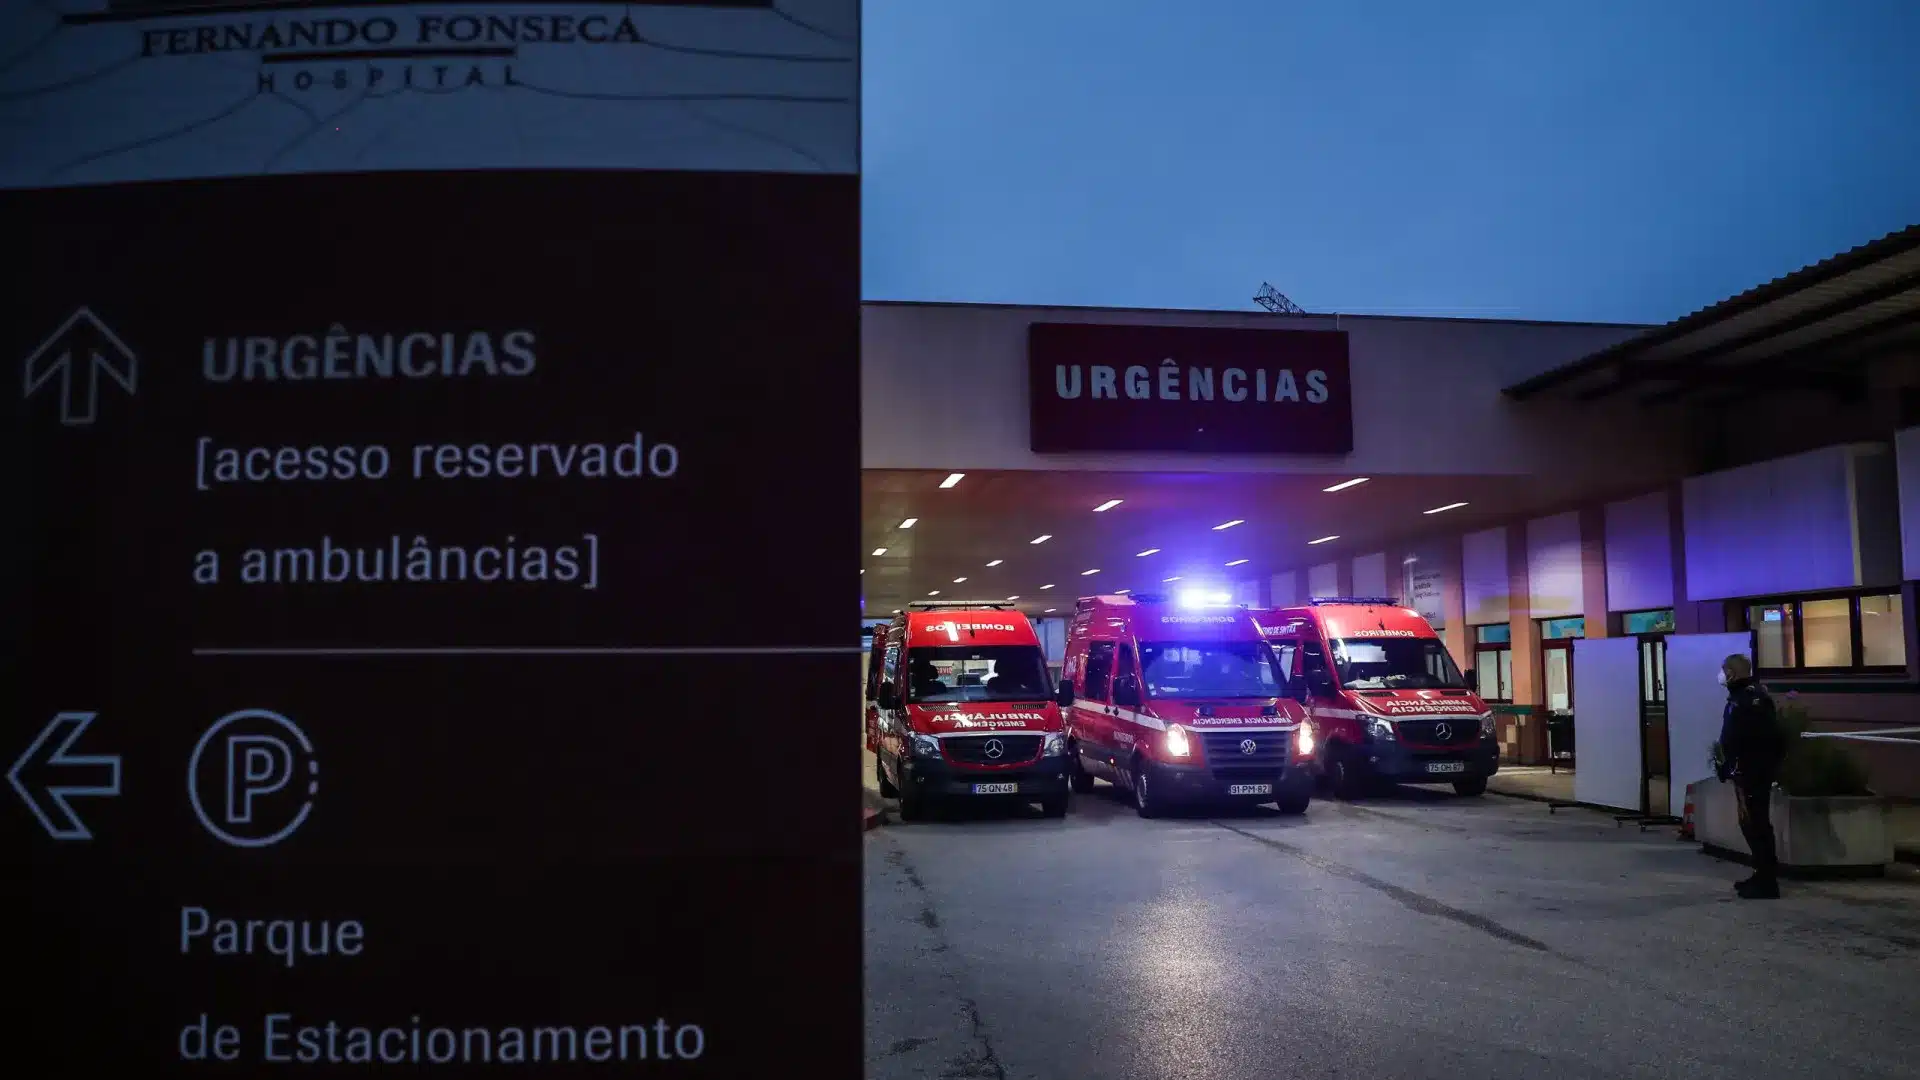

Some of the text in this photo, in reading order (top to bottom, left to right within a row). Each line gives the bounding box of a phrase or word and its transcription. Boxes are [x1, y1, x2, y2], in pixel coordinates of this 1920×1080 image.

[140, 14, 642, 58] FERNANDO FONSECA
[258, 65, 521, 93] HOSPITAL
[203, 324, 537, 381] URGÊNCIAS
[1056, 357, 1329, 403] URGÊNCIAS
[197, 431, 679, 490] [acesso reservado
[193, 533, 598, 589] a ambulâncias]
[227, 735, 293, 824] P
[180, 906, 365, 967] Parque
[179, 1013, 705, 1063] de Estacionamento
